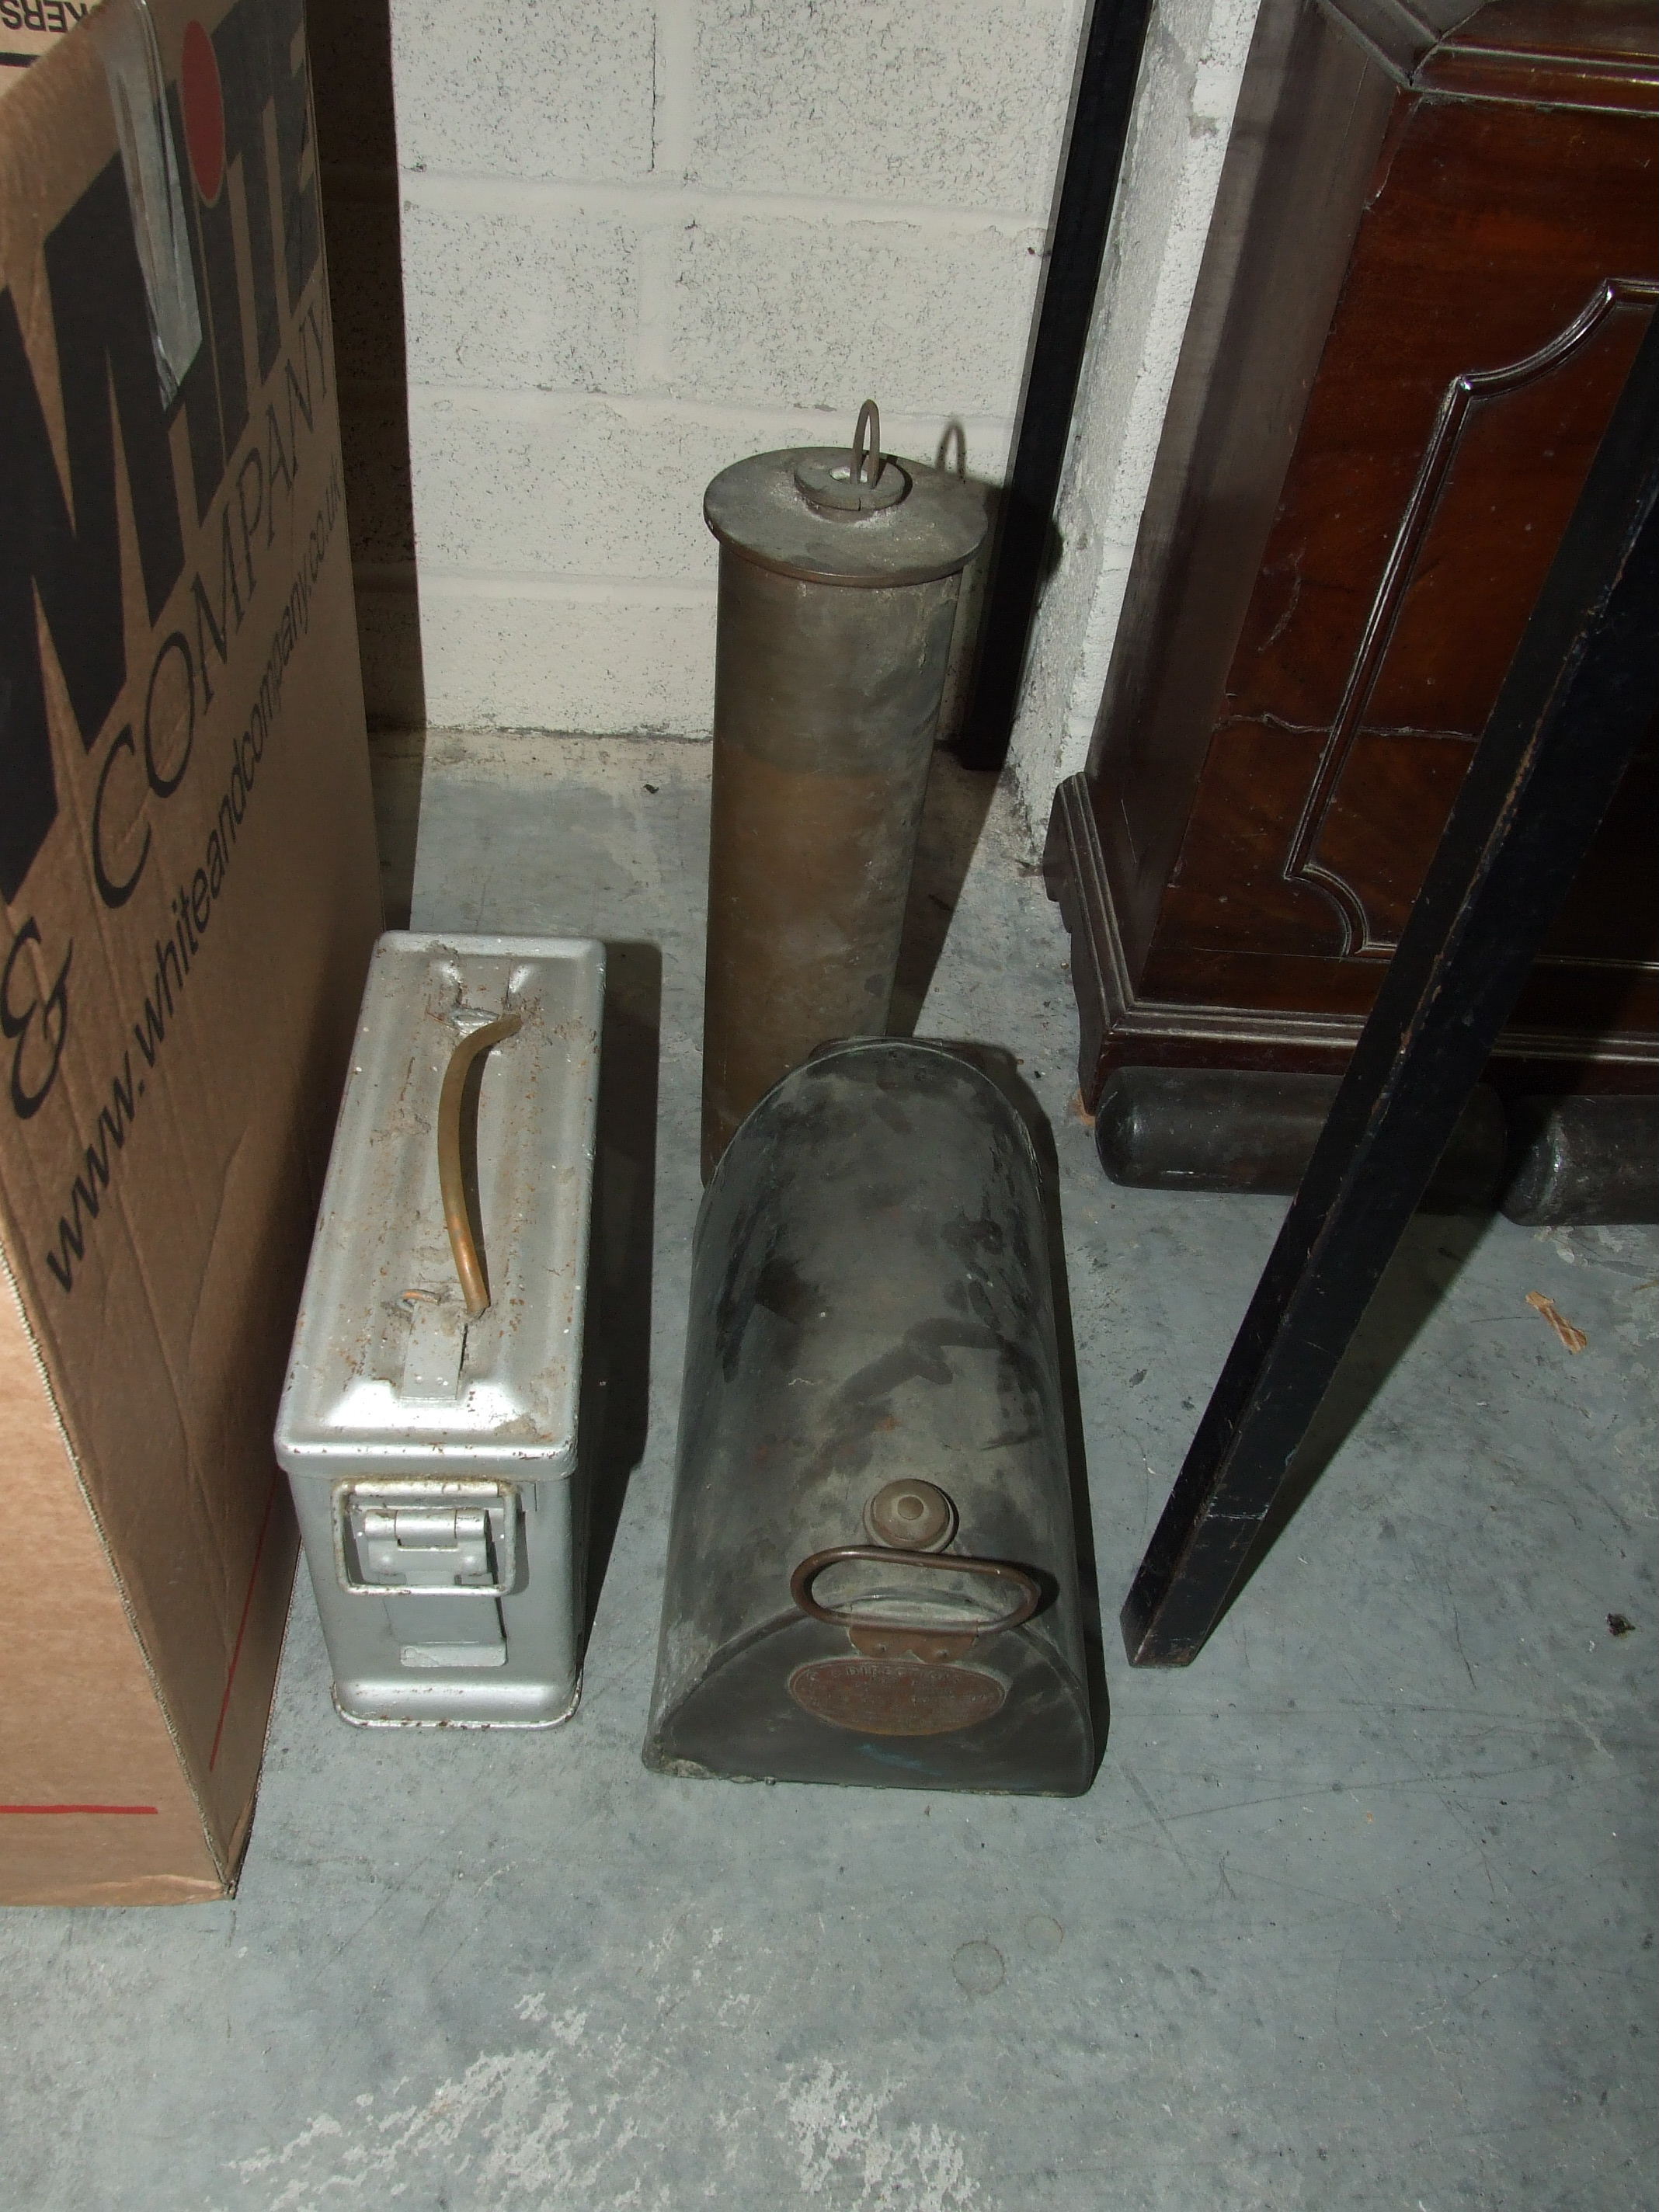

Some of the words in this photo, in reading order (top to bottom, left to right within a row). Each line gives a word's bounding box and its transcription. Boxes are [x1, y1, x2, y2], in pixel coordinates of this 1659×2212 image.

[2, 918, 75, 1120] &
[92, 278, 326, 909] COMPANY
[47, 453, 342, 1294] www.whiteandcompany.co.uk
